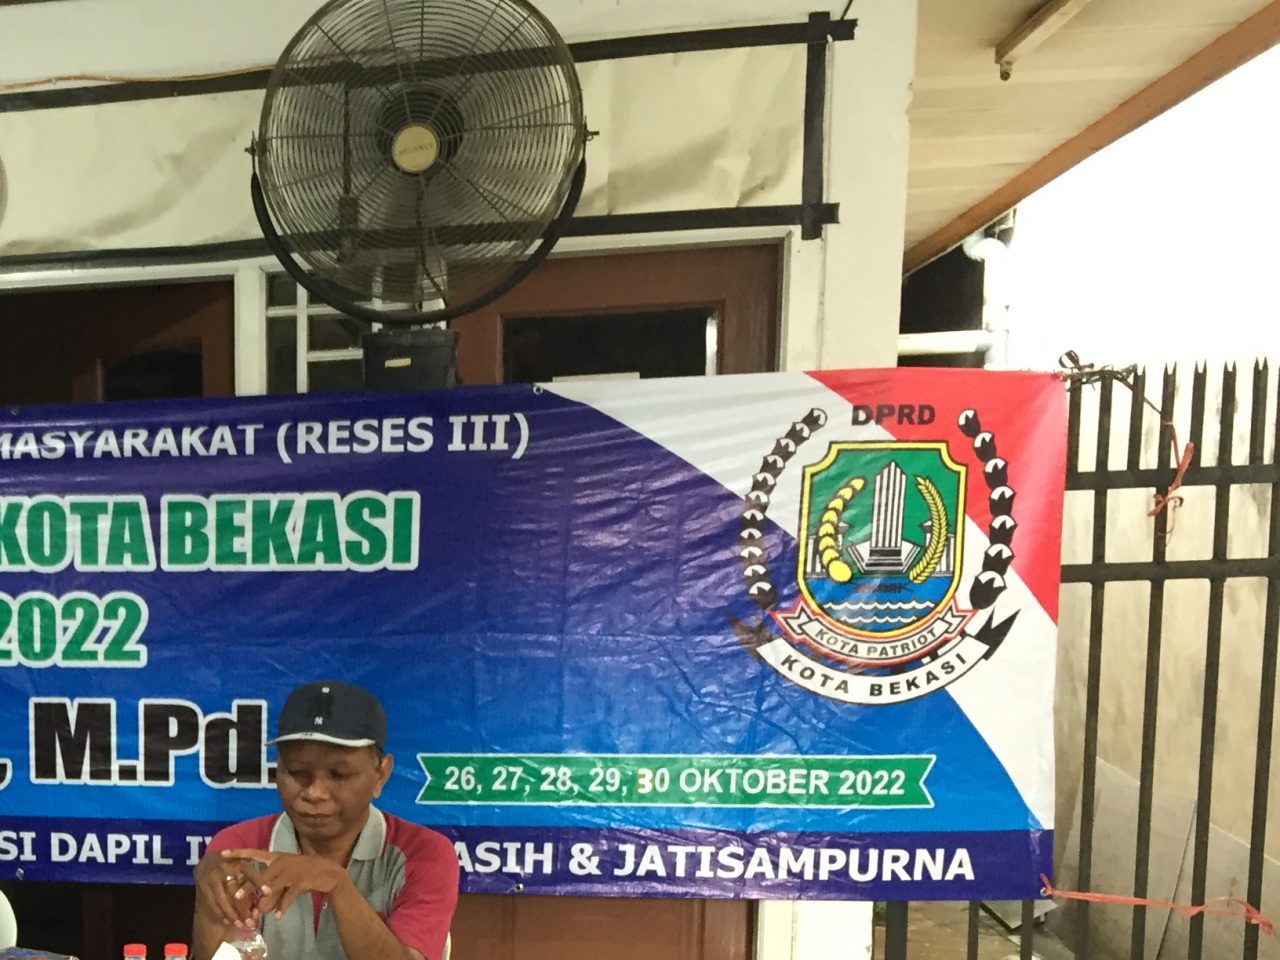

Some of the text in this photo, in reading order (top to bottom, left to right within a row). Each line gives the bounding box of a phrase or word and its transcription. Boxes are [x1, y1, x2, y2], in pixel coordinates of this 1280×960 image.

[852, 405, 936, 426] DPRD
[276, 416, 434, 463] (RESES
[447, 413, 530, 459] III)
[160, 491, 420, 572] BEKASI
[814, 628, 939, 658] KOTA PATRIOT
[780, 652, 968, 697] KOTA BEKASI
[444, 766, 905, 796] 26, 27, 28, 29, 30 OKTOBER 2022
[50, 831, 173, 865] DAPIL
[569, 842, 601, 876] &
[614, 843, 975, 881] JATISAMPURNA
